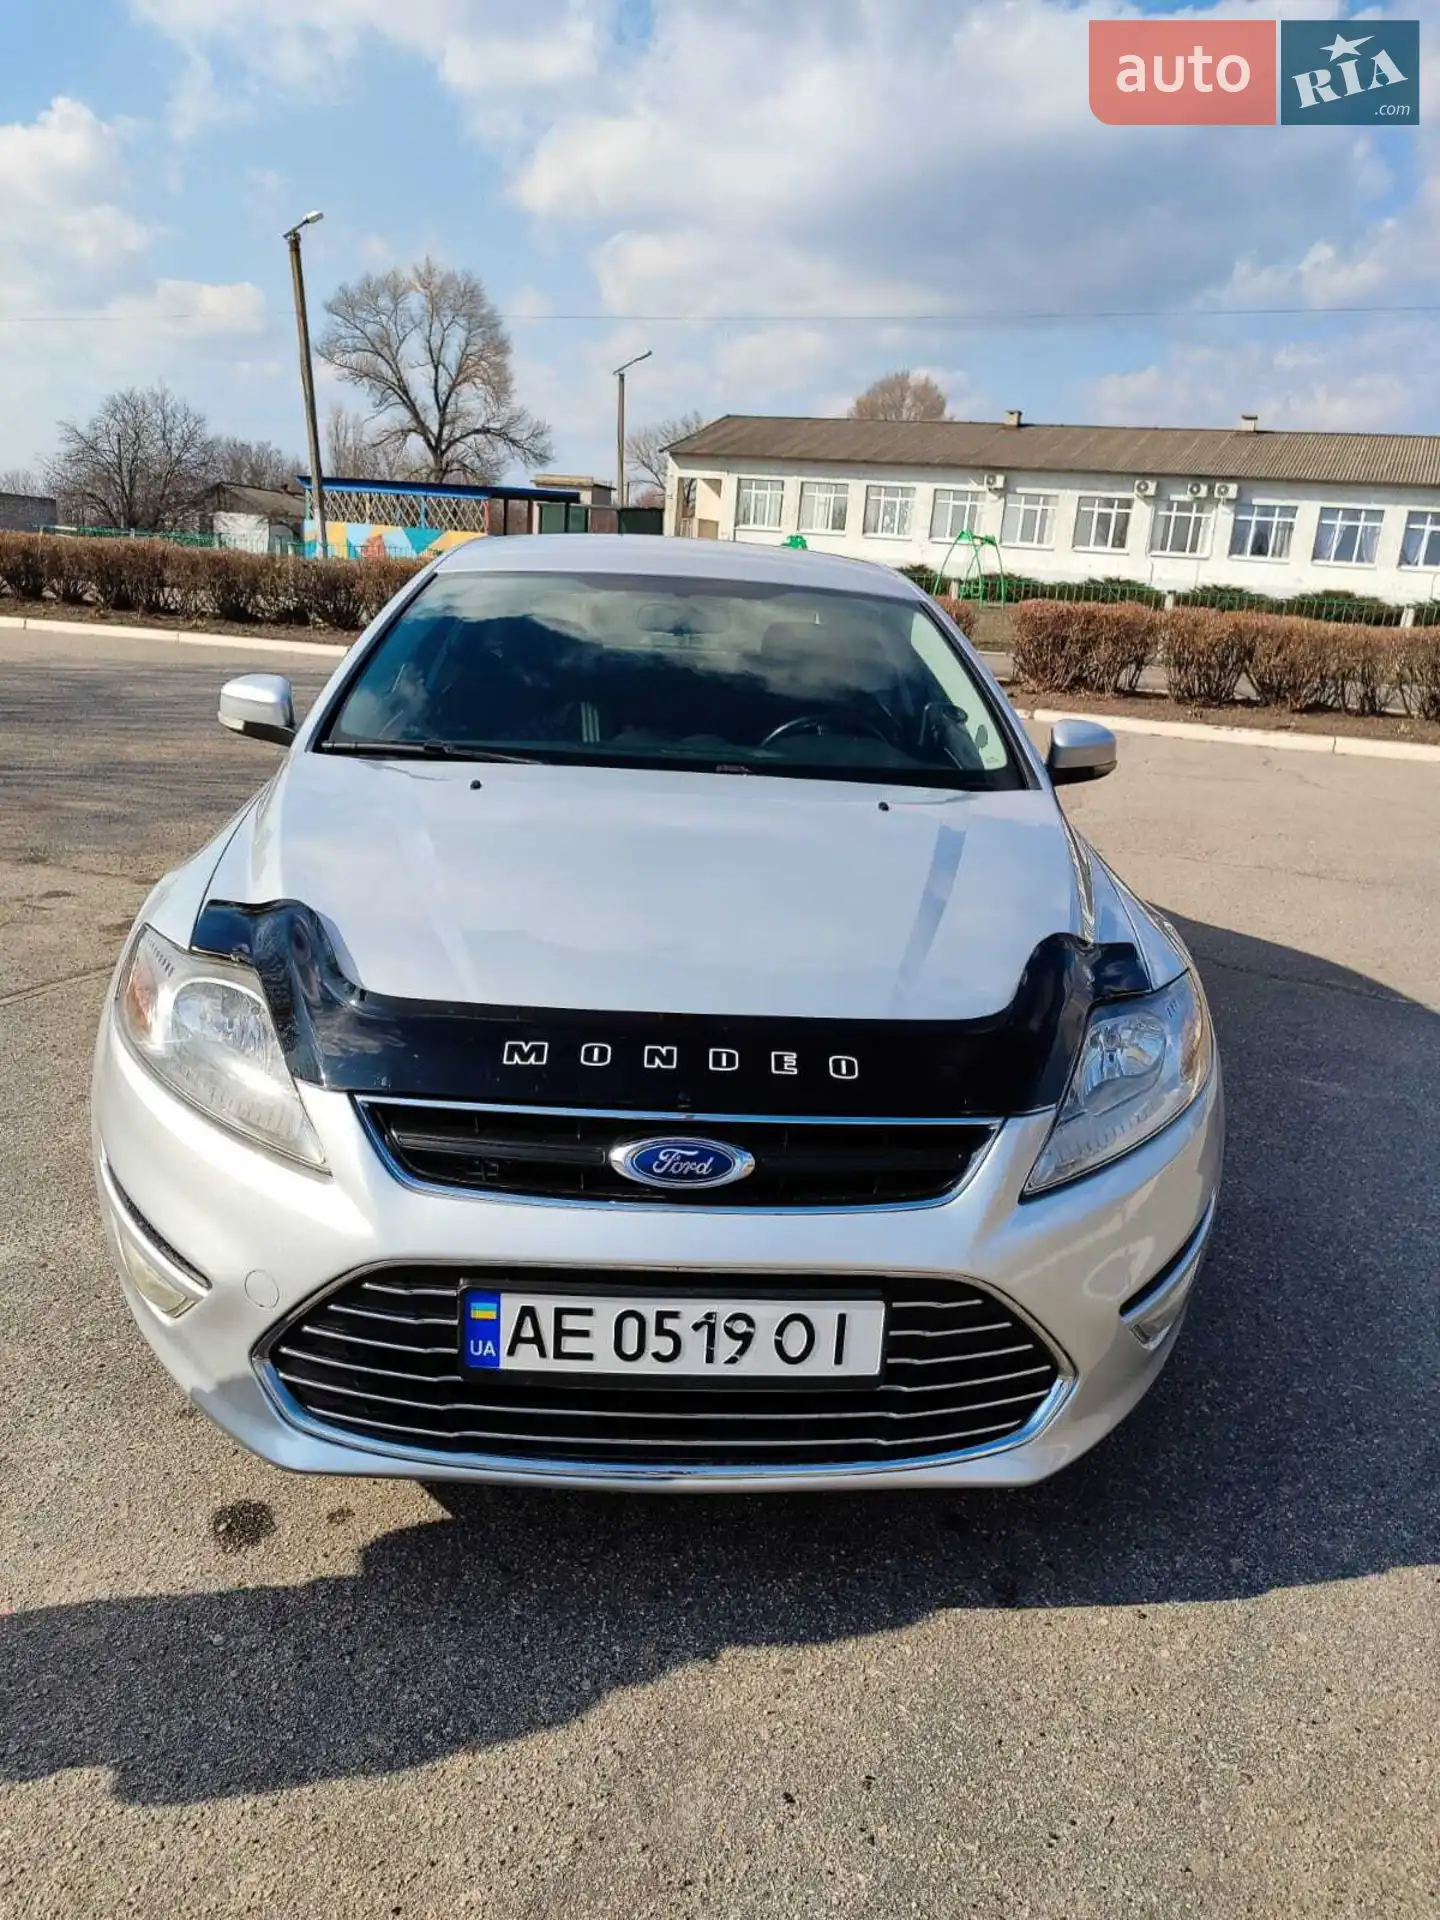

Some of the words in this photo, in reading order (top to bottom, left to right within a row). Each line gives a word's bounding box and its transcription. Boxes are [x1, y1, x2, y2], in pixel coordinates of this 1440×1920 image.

[503, 1041, 859, 1079] MONDEO
[652, 1148, 713, 1176] Ford
[470, 1340, 496, 1357] UA
[506, 1305, 595, 1361] AE
[612, 1308, 756, 1365] 0519
